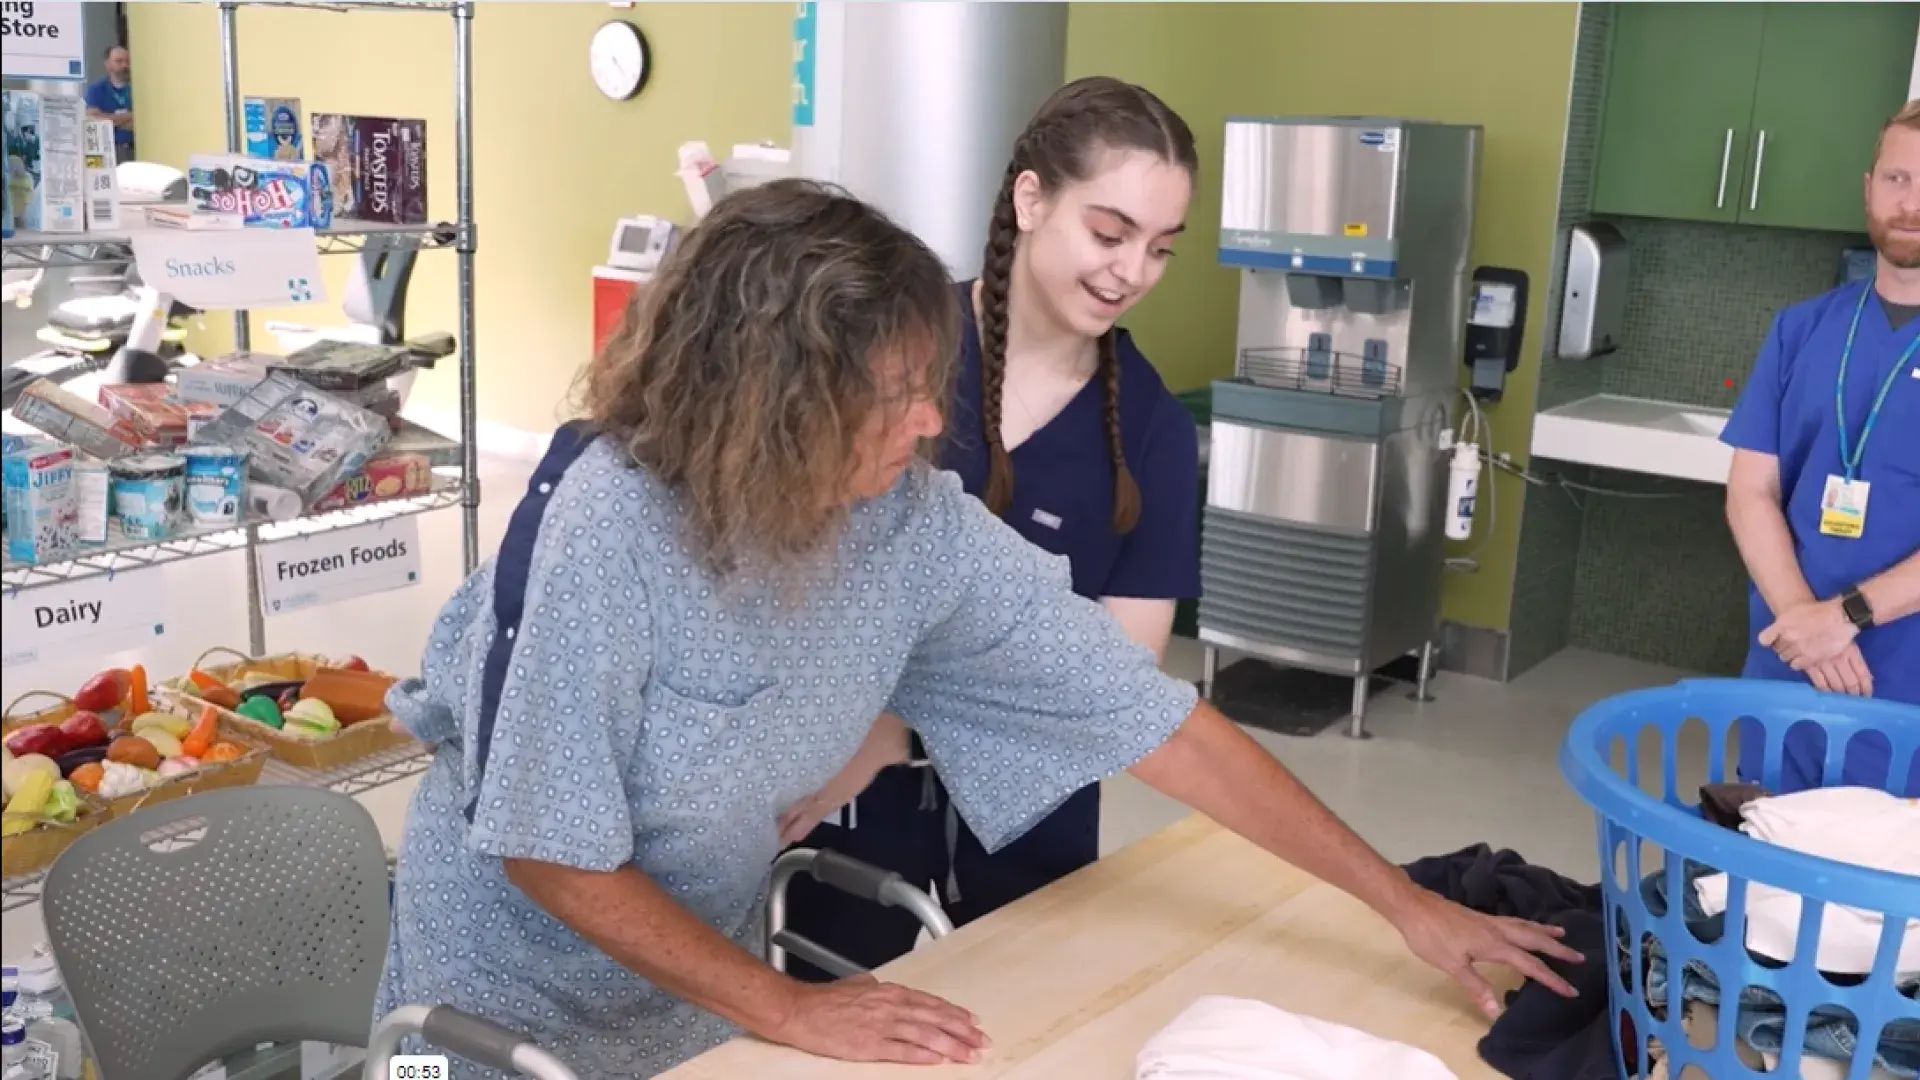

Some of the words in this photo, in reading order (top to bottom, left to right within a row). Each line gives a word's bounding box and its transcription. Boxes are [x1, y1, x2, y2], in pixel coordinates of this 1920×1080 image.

[2, 18, 59, 38] Store
[165, 256, 236, 278] Snacks
[277, 553, 345, 580] Frozen
[350, 538, 407, 566] Foods
[34, 599, 102, 629] Dairy
